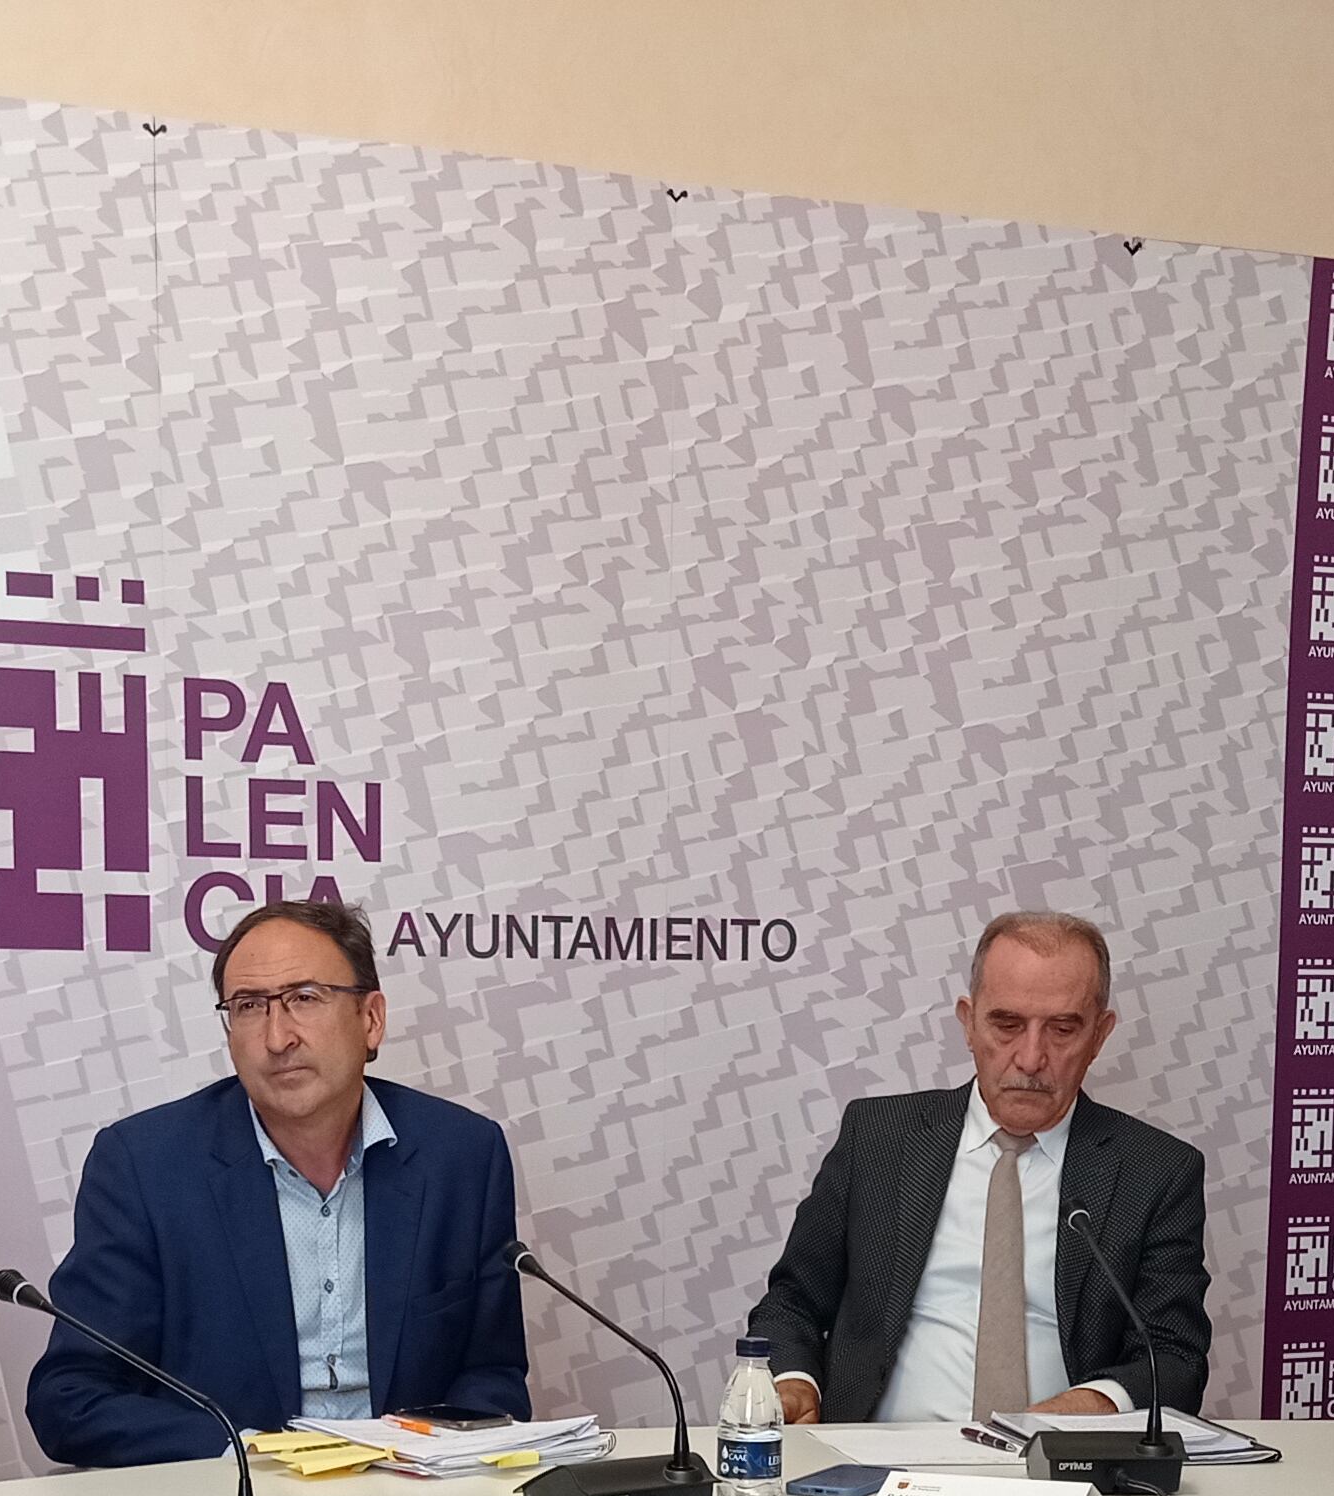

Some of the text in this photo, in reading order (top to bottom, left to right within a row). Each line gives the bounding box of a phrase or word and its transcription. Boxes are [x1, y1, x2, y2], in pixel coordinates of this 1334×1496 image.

[183, 677, 316, 766] PA
[185, 775, 382, 863] LEN
[386, 911, 797, 963] AYUNTAMIENTO
[1058, 1461, 1093, 1471] OPTIMUS
